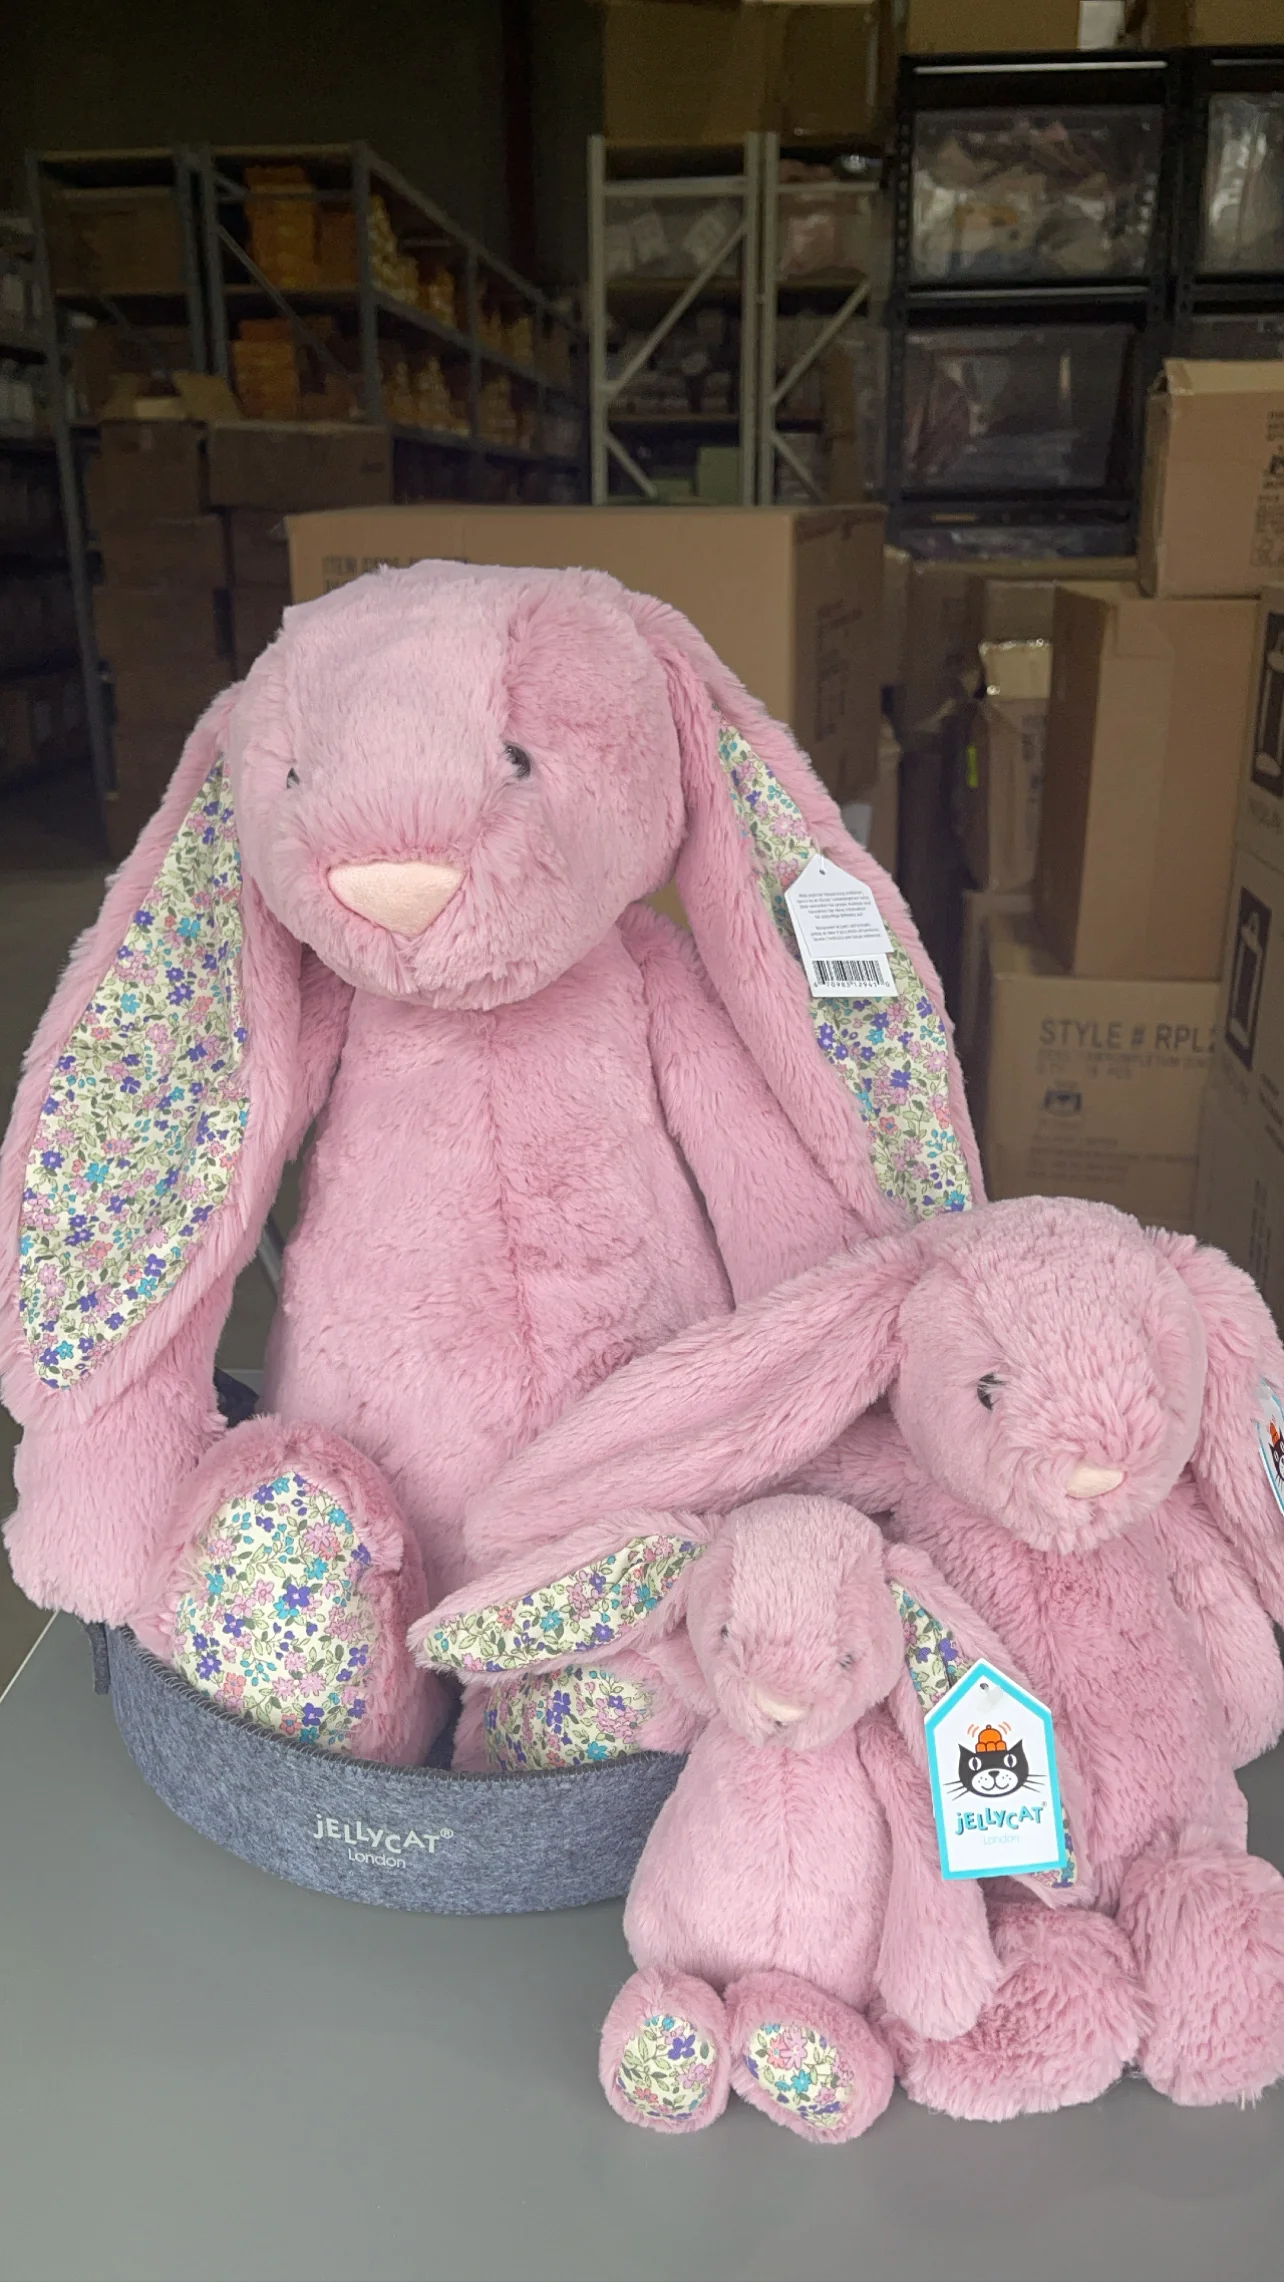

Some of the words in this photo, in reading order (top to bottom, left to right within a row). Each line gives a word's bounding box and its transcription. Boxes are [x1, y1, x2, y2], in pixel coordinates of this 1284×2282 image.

[1039, 1016, 1123, 1048] STYLE
[1131, 1023, 1147, 1048] #
[982, 1833, 1020, 1845] London
[347, 1848, 406, 1869] London
